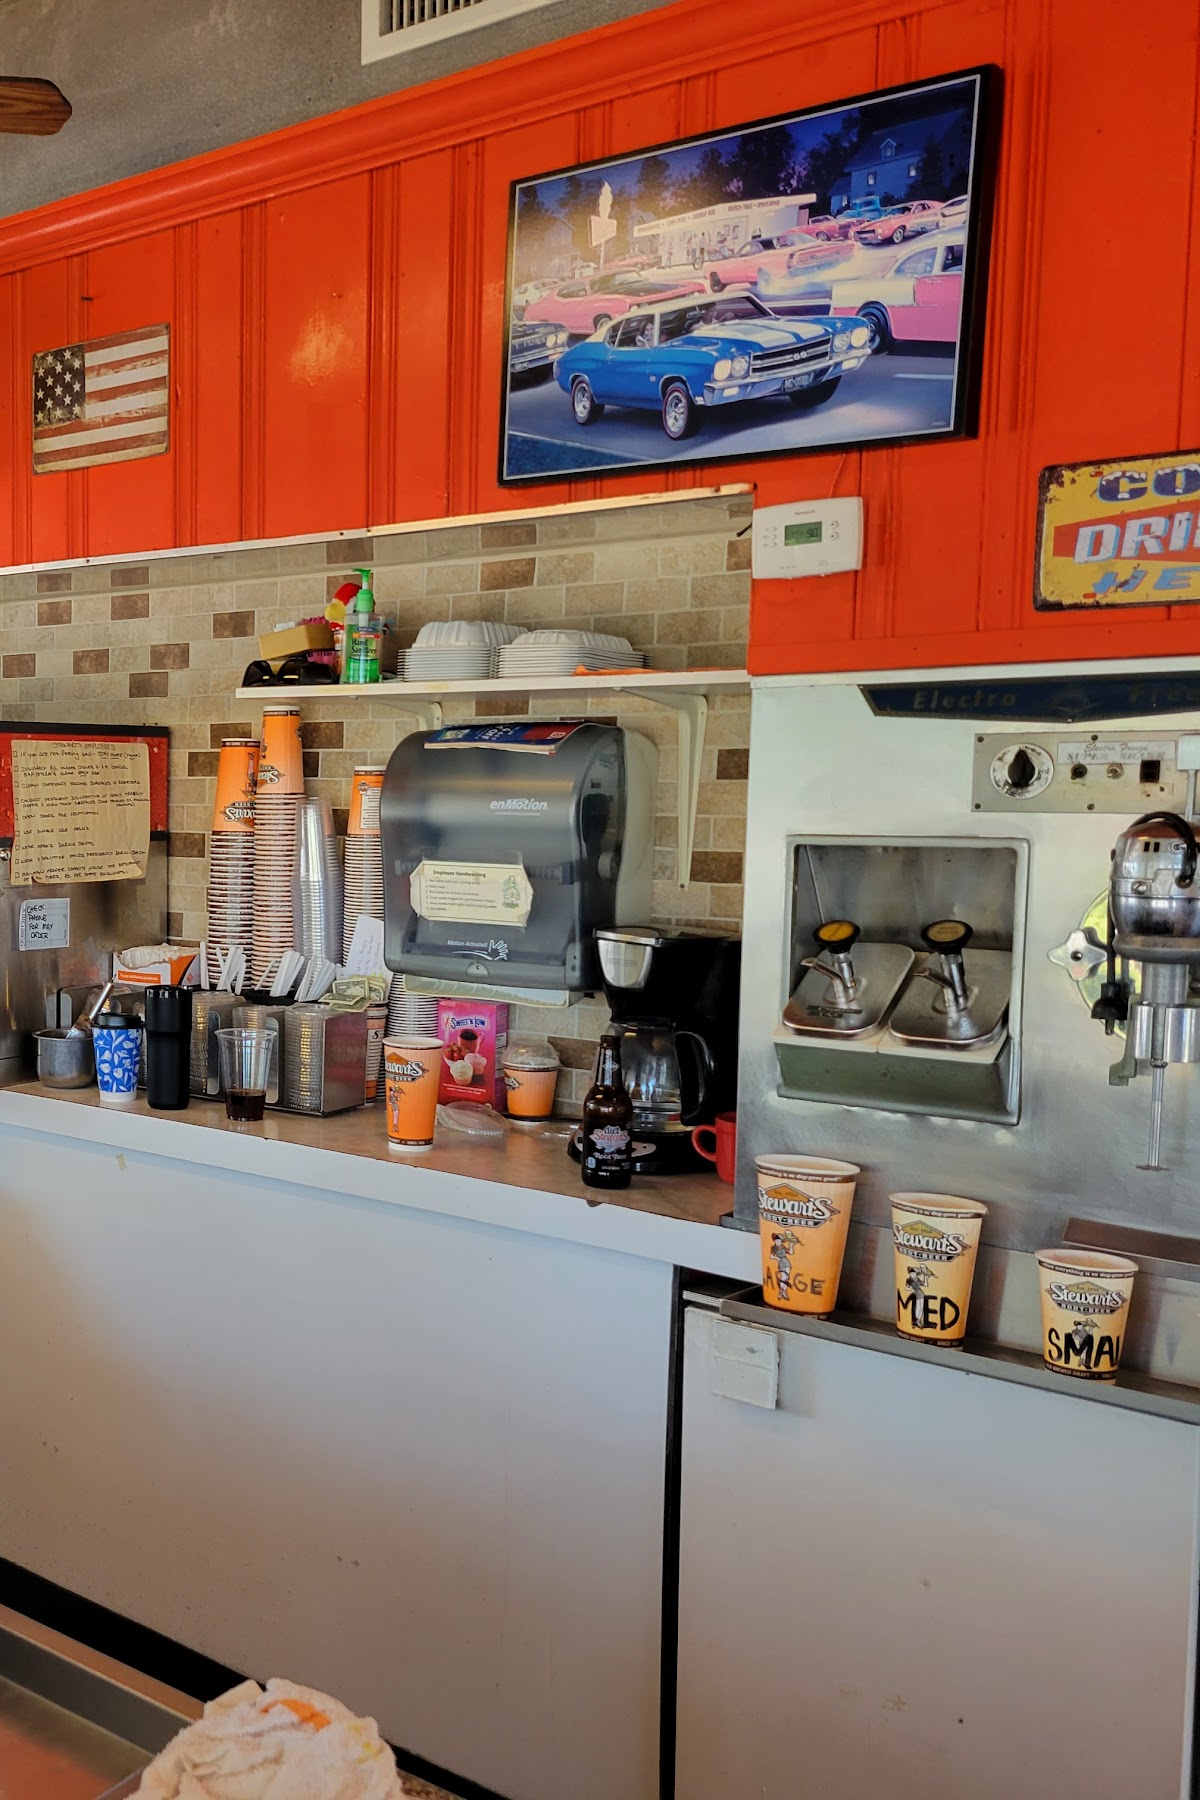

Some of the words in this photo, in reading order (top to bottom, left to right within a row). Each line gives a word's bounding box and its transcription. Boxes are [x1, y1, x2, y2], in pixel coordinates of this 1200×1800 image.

[1073, 511, 1200, 564] DRI
[489, 797, 548, 811] enMotion
[30, 931, 49, 940] ORDER
[764, 1266, 826, 1296] ARGE
[1054, 1265, 1084, 1276] everything
[897, 1288, 960, 1331] MED
